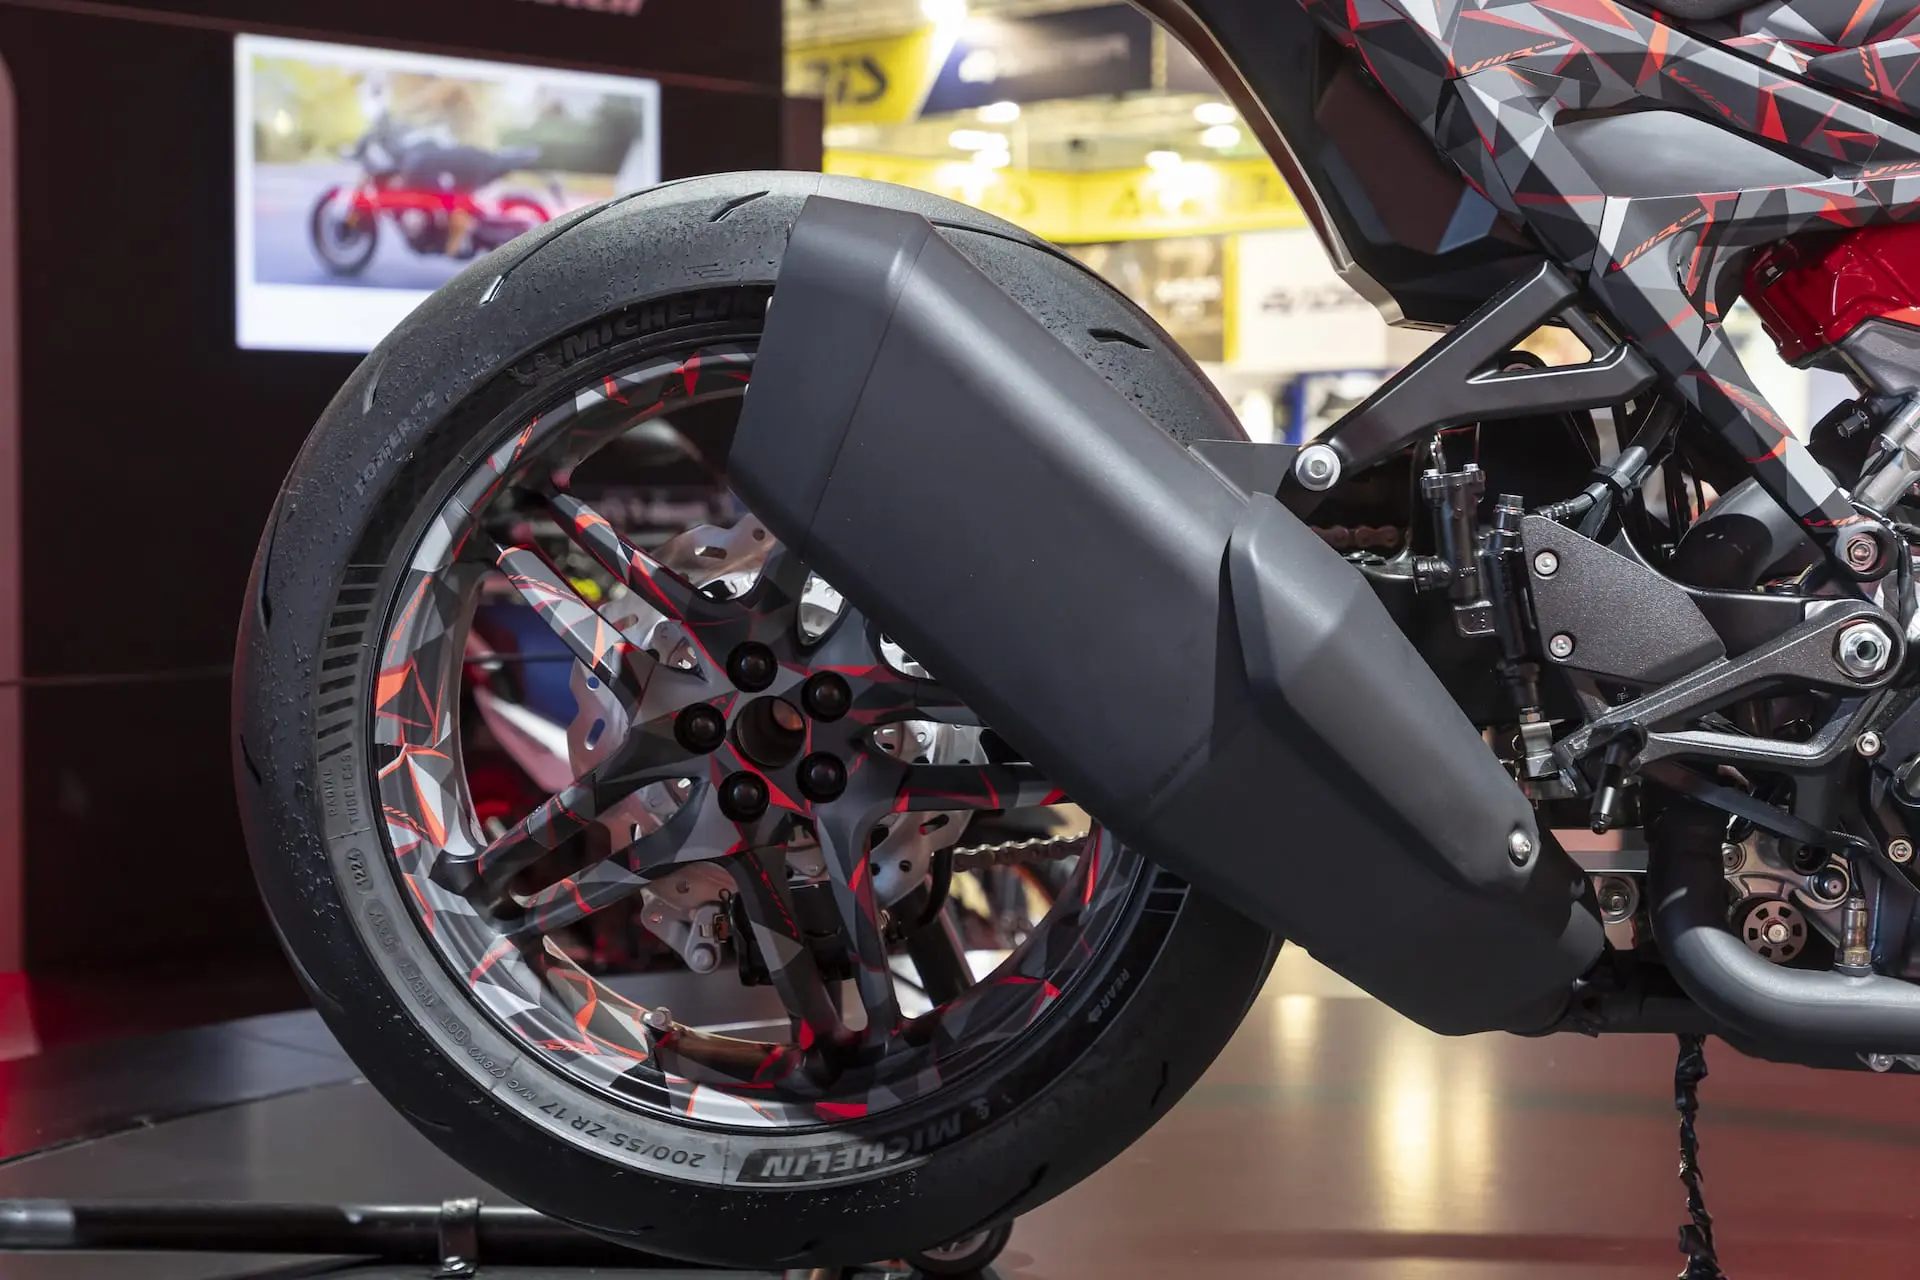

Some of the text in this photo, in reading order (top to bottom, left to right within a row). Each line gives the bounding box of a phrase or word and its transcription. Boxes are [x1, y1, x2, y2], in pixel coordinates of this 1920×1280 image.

[562, 291, 762, 362] MICHELIN
[322, 769, 338, 818] RADIAL
[340, 754, 360, 825] TUBELESS
[348, 851, 368, 886] 1224
[1100, 968, 1130, 1009] REAR
[441, 1015, 468, 1046] DOT
[467, 1046, 706, 1168] 200/55 ZR 17 M/C (78W)
[761, 1112, 961, 1177] MICHELIN
